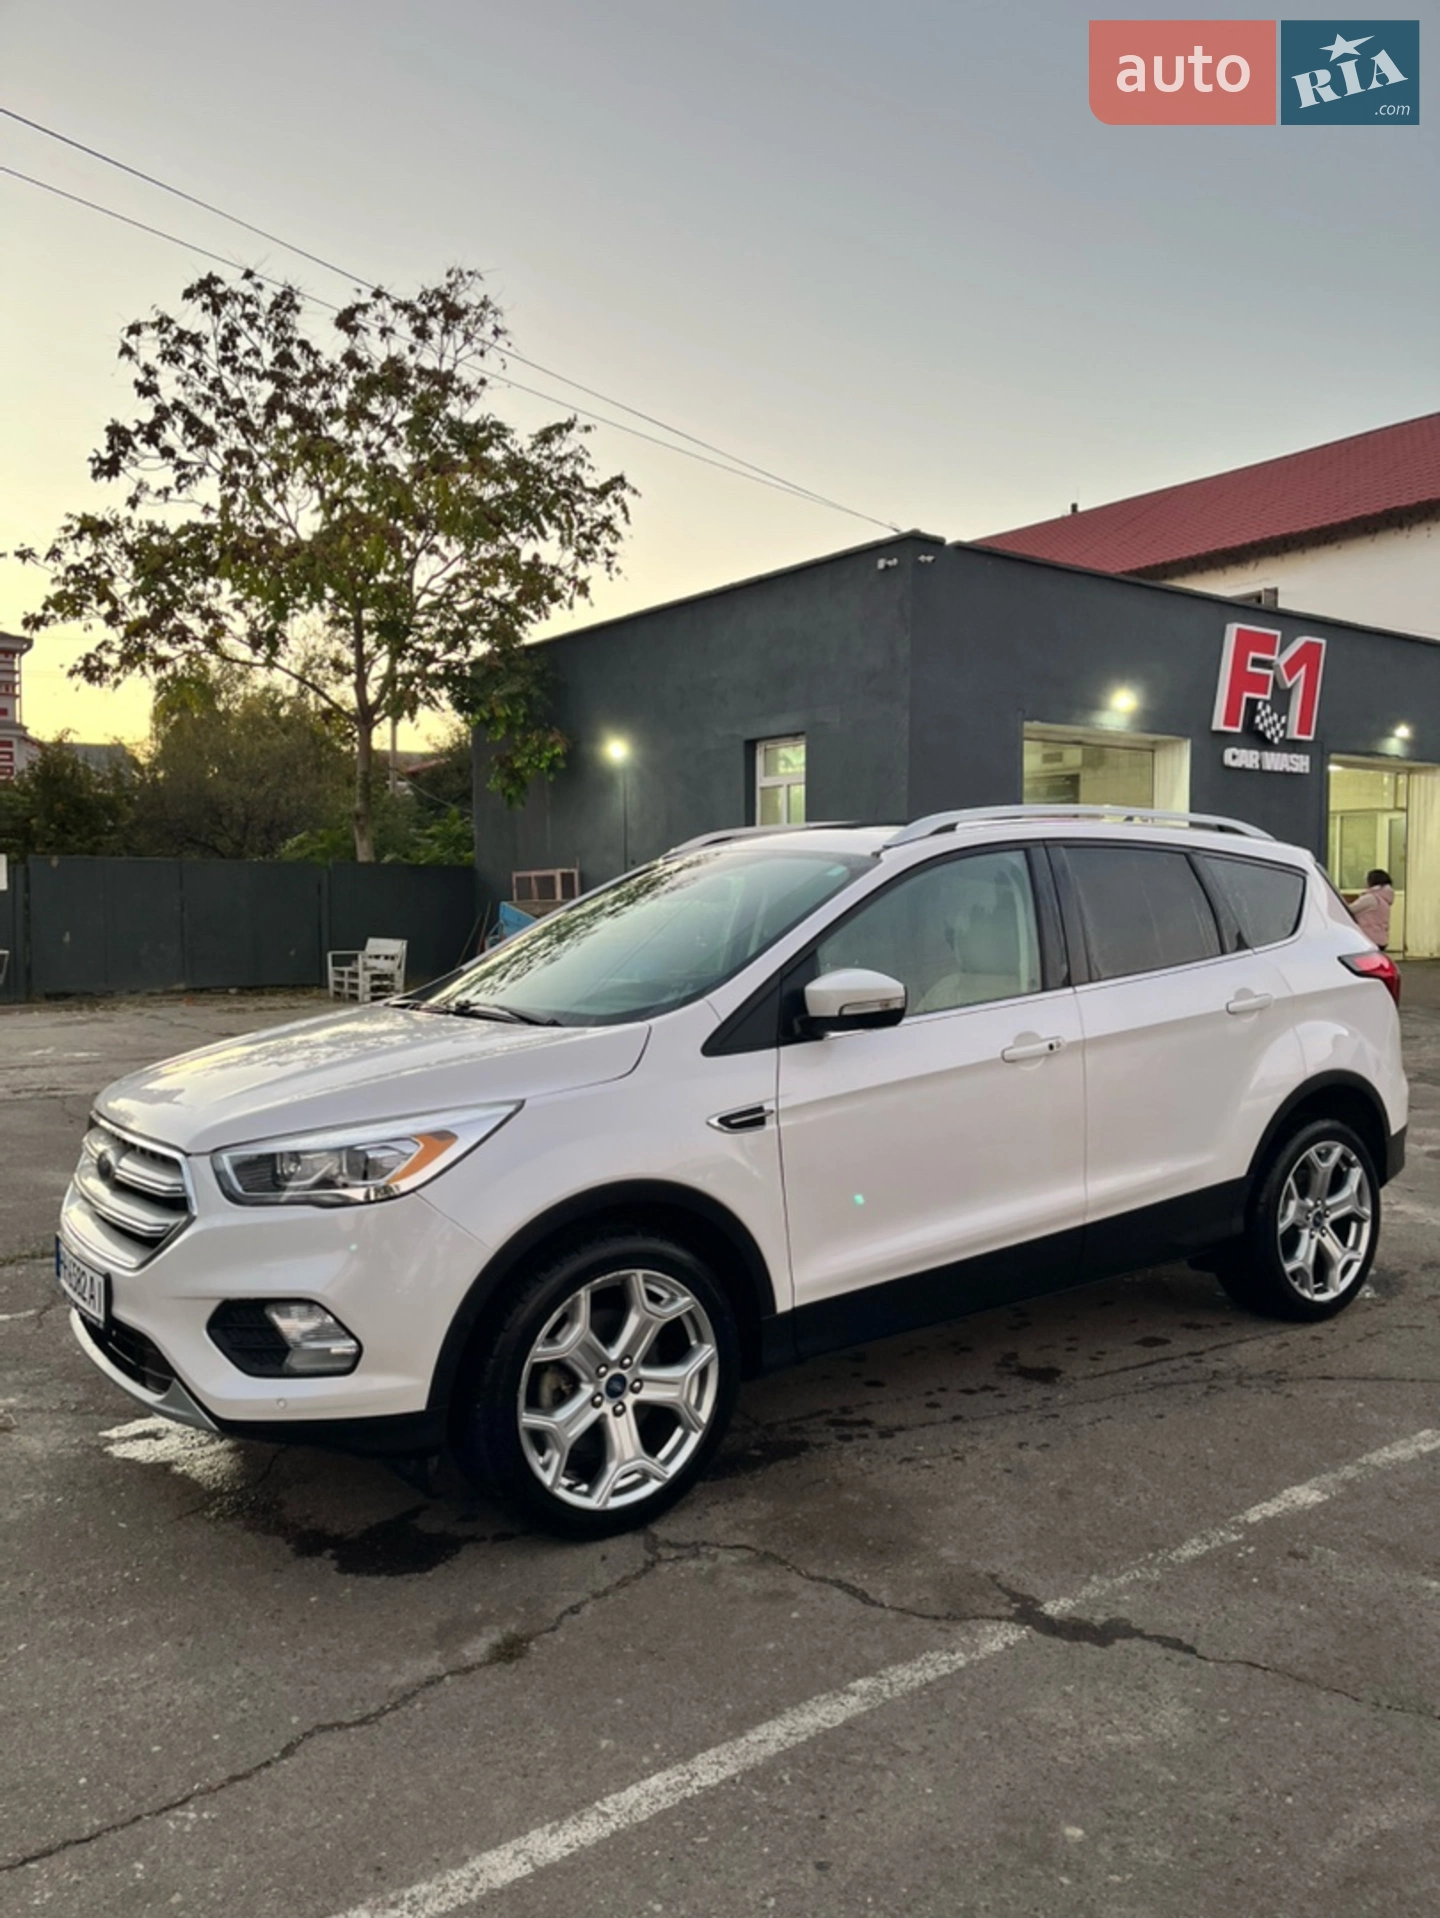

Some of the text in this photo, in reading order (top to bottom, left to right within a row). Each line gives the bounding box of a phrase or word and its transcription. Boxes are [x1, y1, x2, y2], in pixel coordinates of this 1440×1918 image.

[1211, 622, 1326, 741] F1
[1223, 747, 1311, 774] CAR WASH
